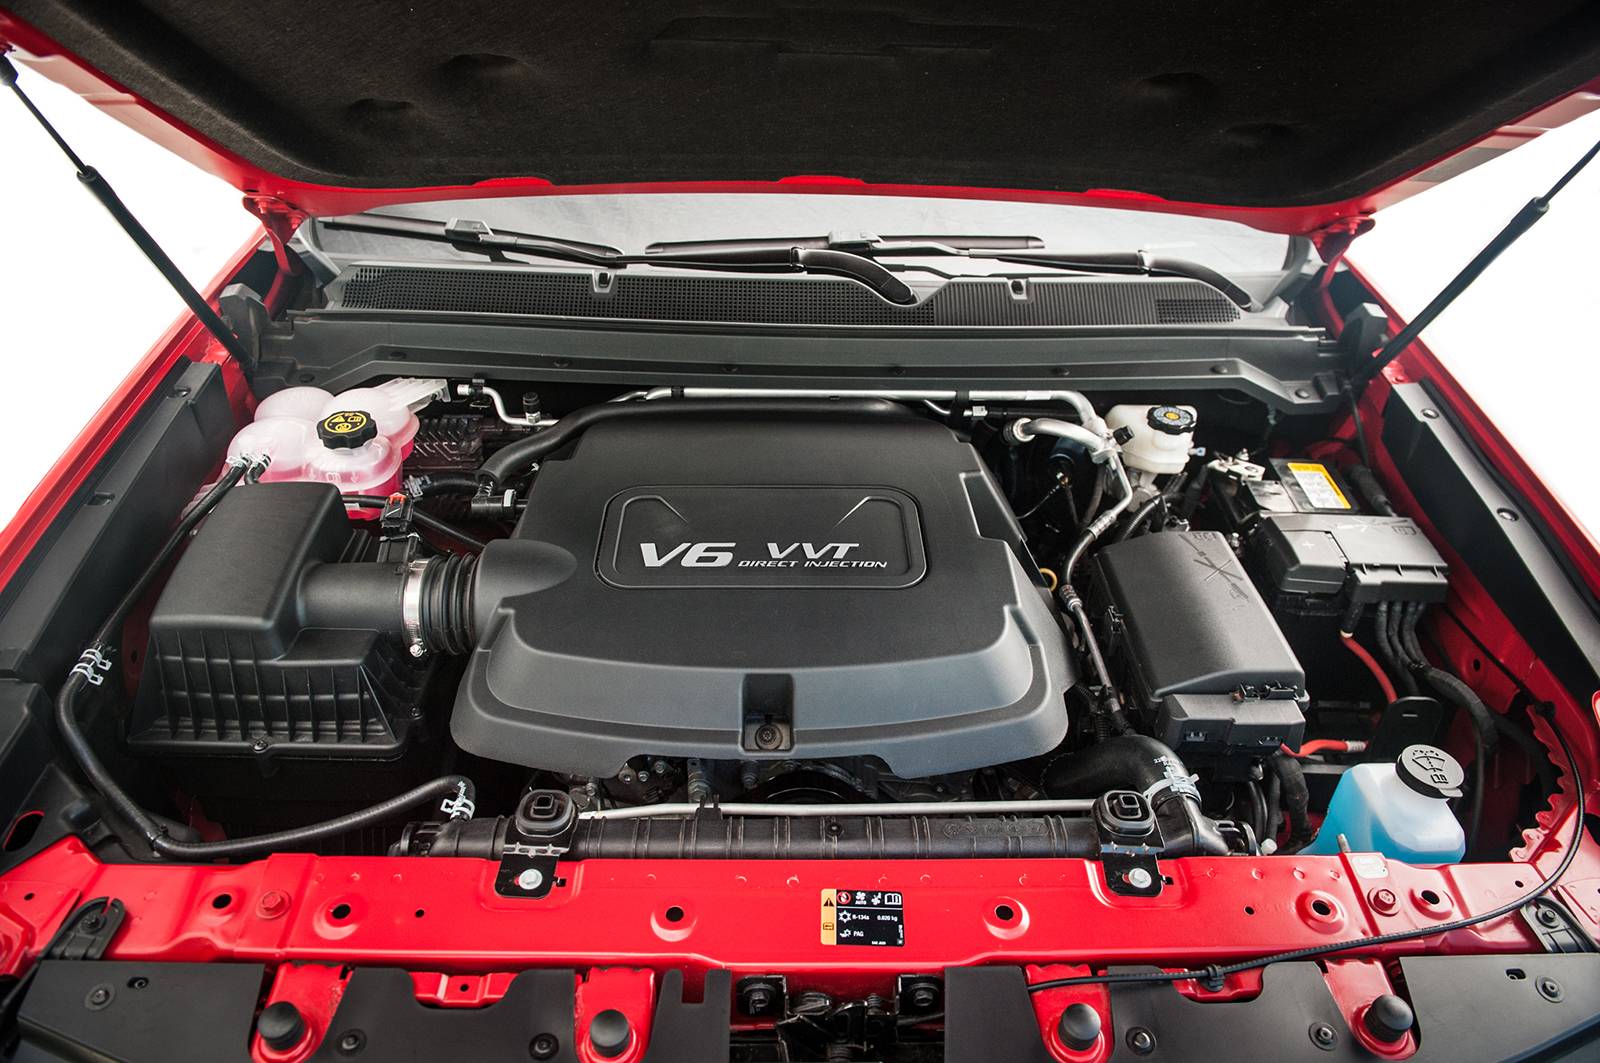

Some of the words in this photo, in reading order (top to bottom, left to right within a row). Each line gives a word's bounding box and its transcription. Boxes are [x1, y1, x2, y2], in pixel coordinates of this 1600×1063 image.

[640, 542, 736, 567] V6
[767, 542, 859, 560] VVT
[738, 559, 799, 568] DIRECT
[804, 559, 888, 569] INJECTION
